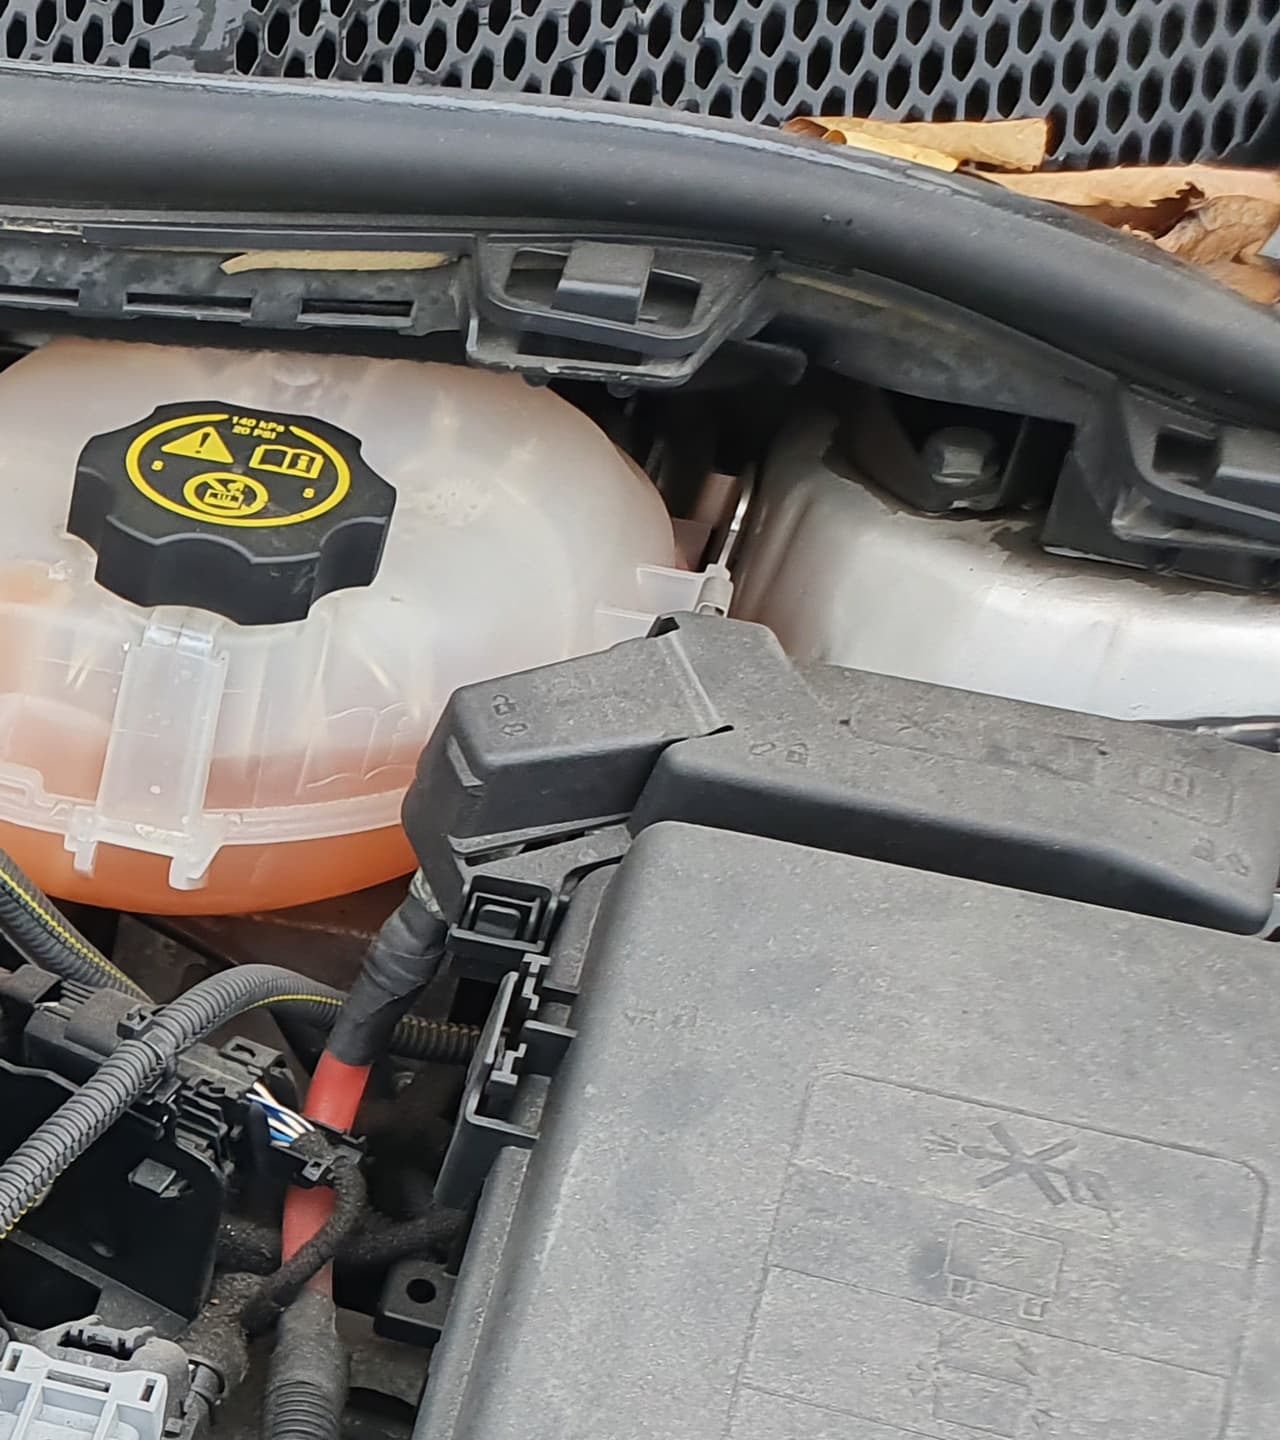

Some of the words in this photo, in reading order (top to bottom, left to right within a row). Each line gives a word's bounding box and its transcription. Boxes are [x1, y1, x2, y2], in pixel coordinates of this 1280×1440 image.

[232, 415, 257, 428] 140
[258, 420, 286, 433] kPa
[252, 428, 277, 440] PSI
